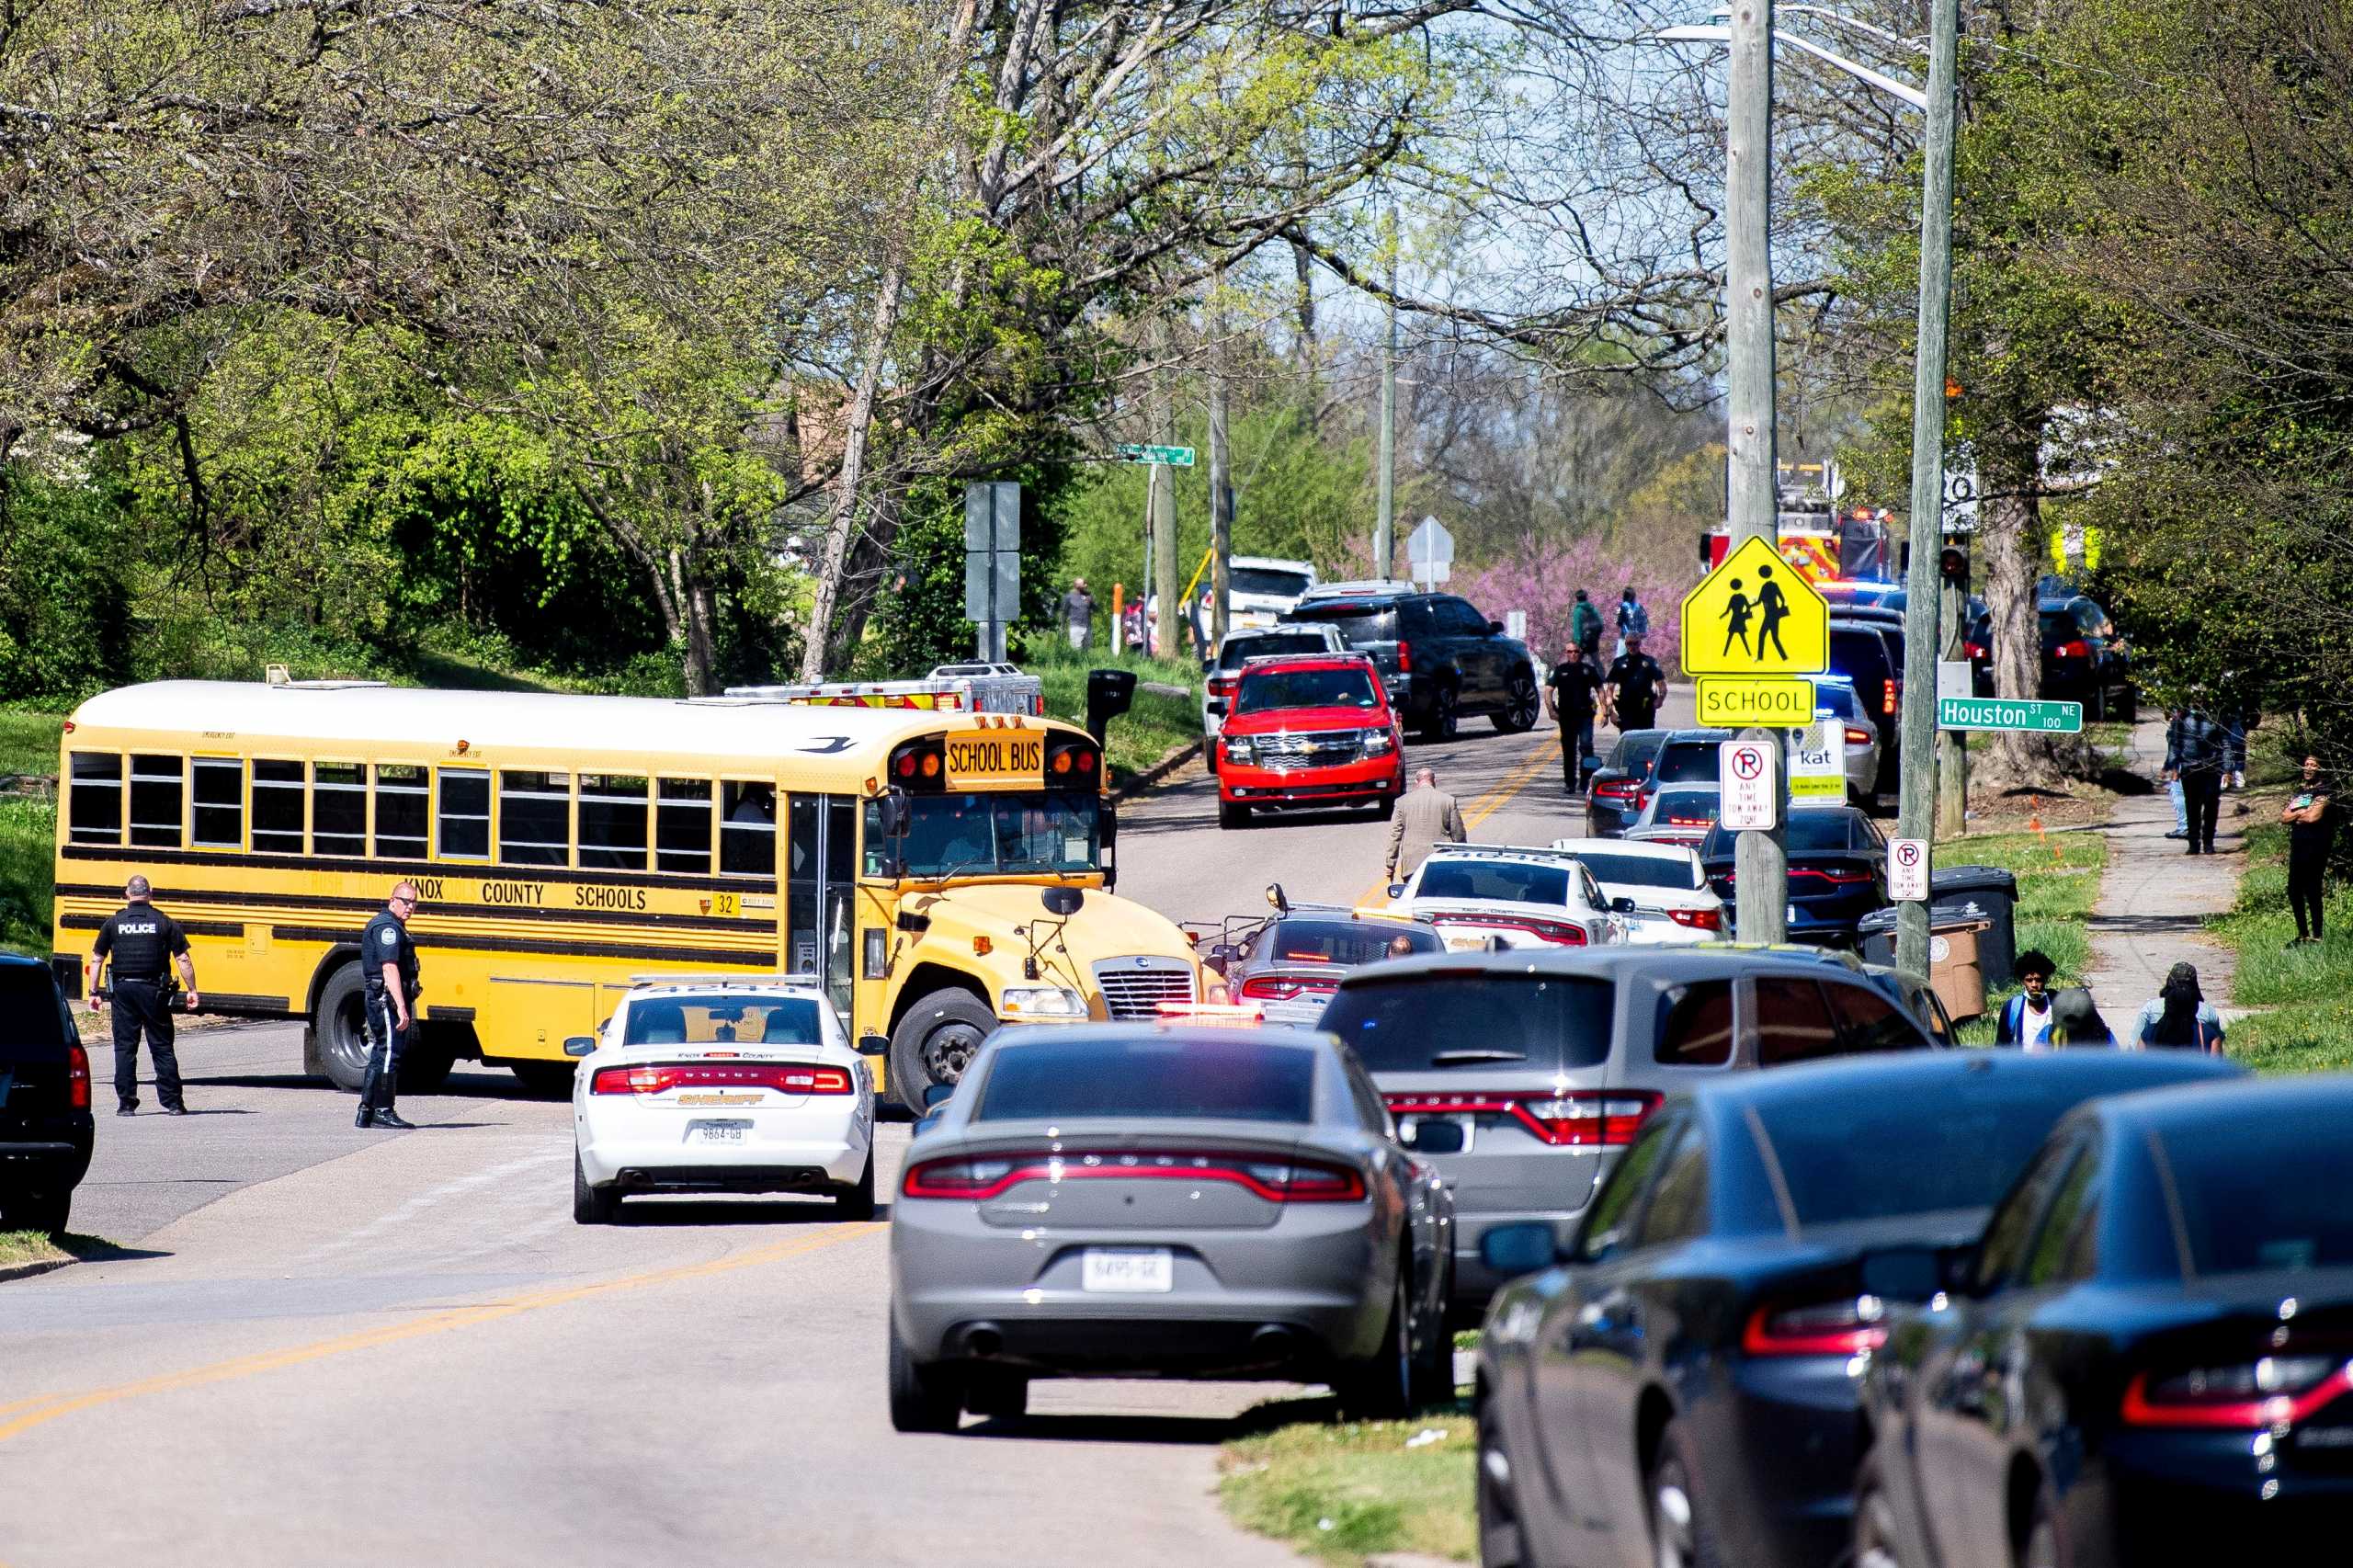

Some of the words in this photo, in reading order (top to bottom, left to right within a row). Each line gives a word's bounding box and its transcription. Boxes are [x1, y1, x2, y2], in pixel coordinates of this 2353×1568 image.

[1708, 692, 1805, 710] SCHOOL
[1944, 701, 2026, 725] Houston
[2029, 704, 2042, 714] ST
[2062, 706, 2075, 716] NE
[2043, 718, 2061, 728] 100
[949, 743, 1006, 772] SCHOOL
[1011, 743, 1040, 770] BUS
[1802, 750, 1831, 764] kat
[1740, 782, 1756, 790] ANY
[1739, 793, 1756, 802] TIME
[1729, 804, 1743, 812] TOW
[483, 882, 543, 904] COUNTY
[575, 886, 646, 910] SCHOOLS
[719, 895, 733, 913] 32
[118, 924, 156, 934] POLICE
[677, 1094, 765, 1105] SHERIFF
